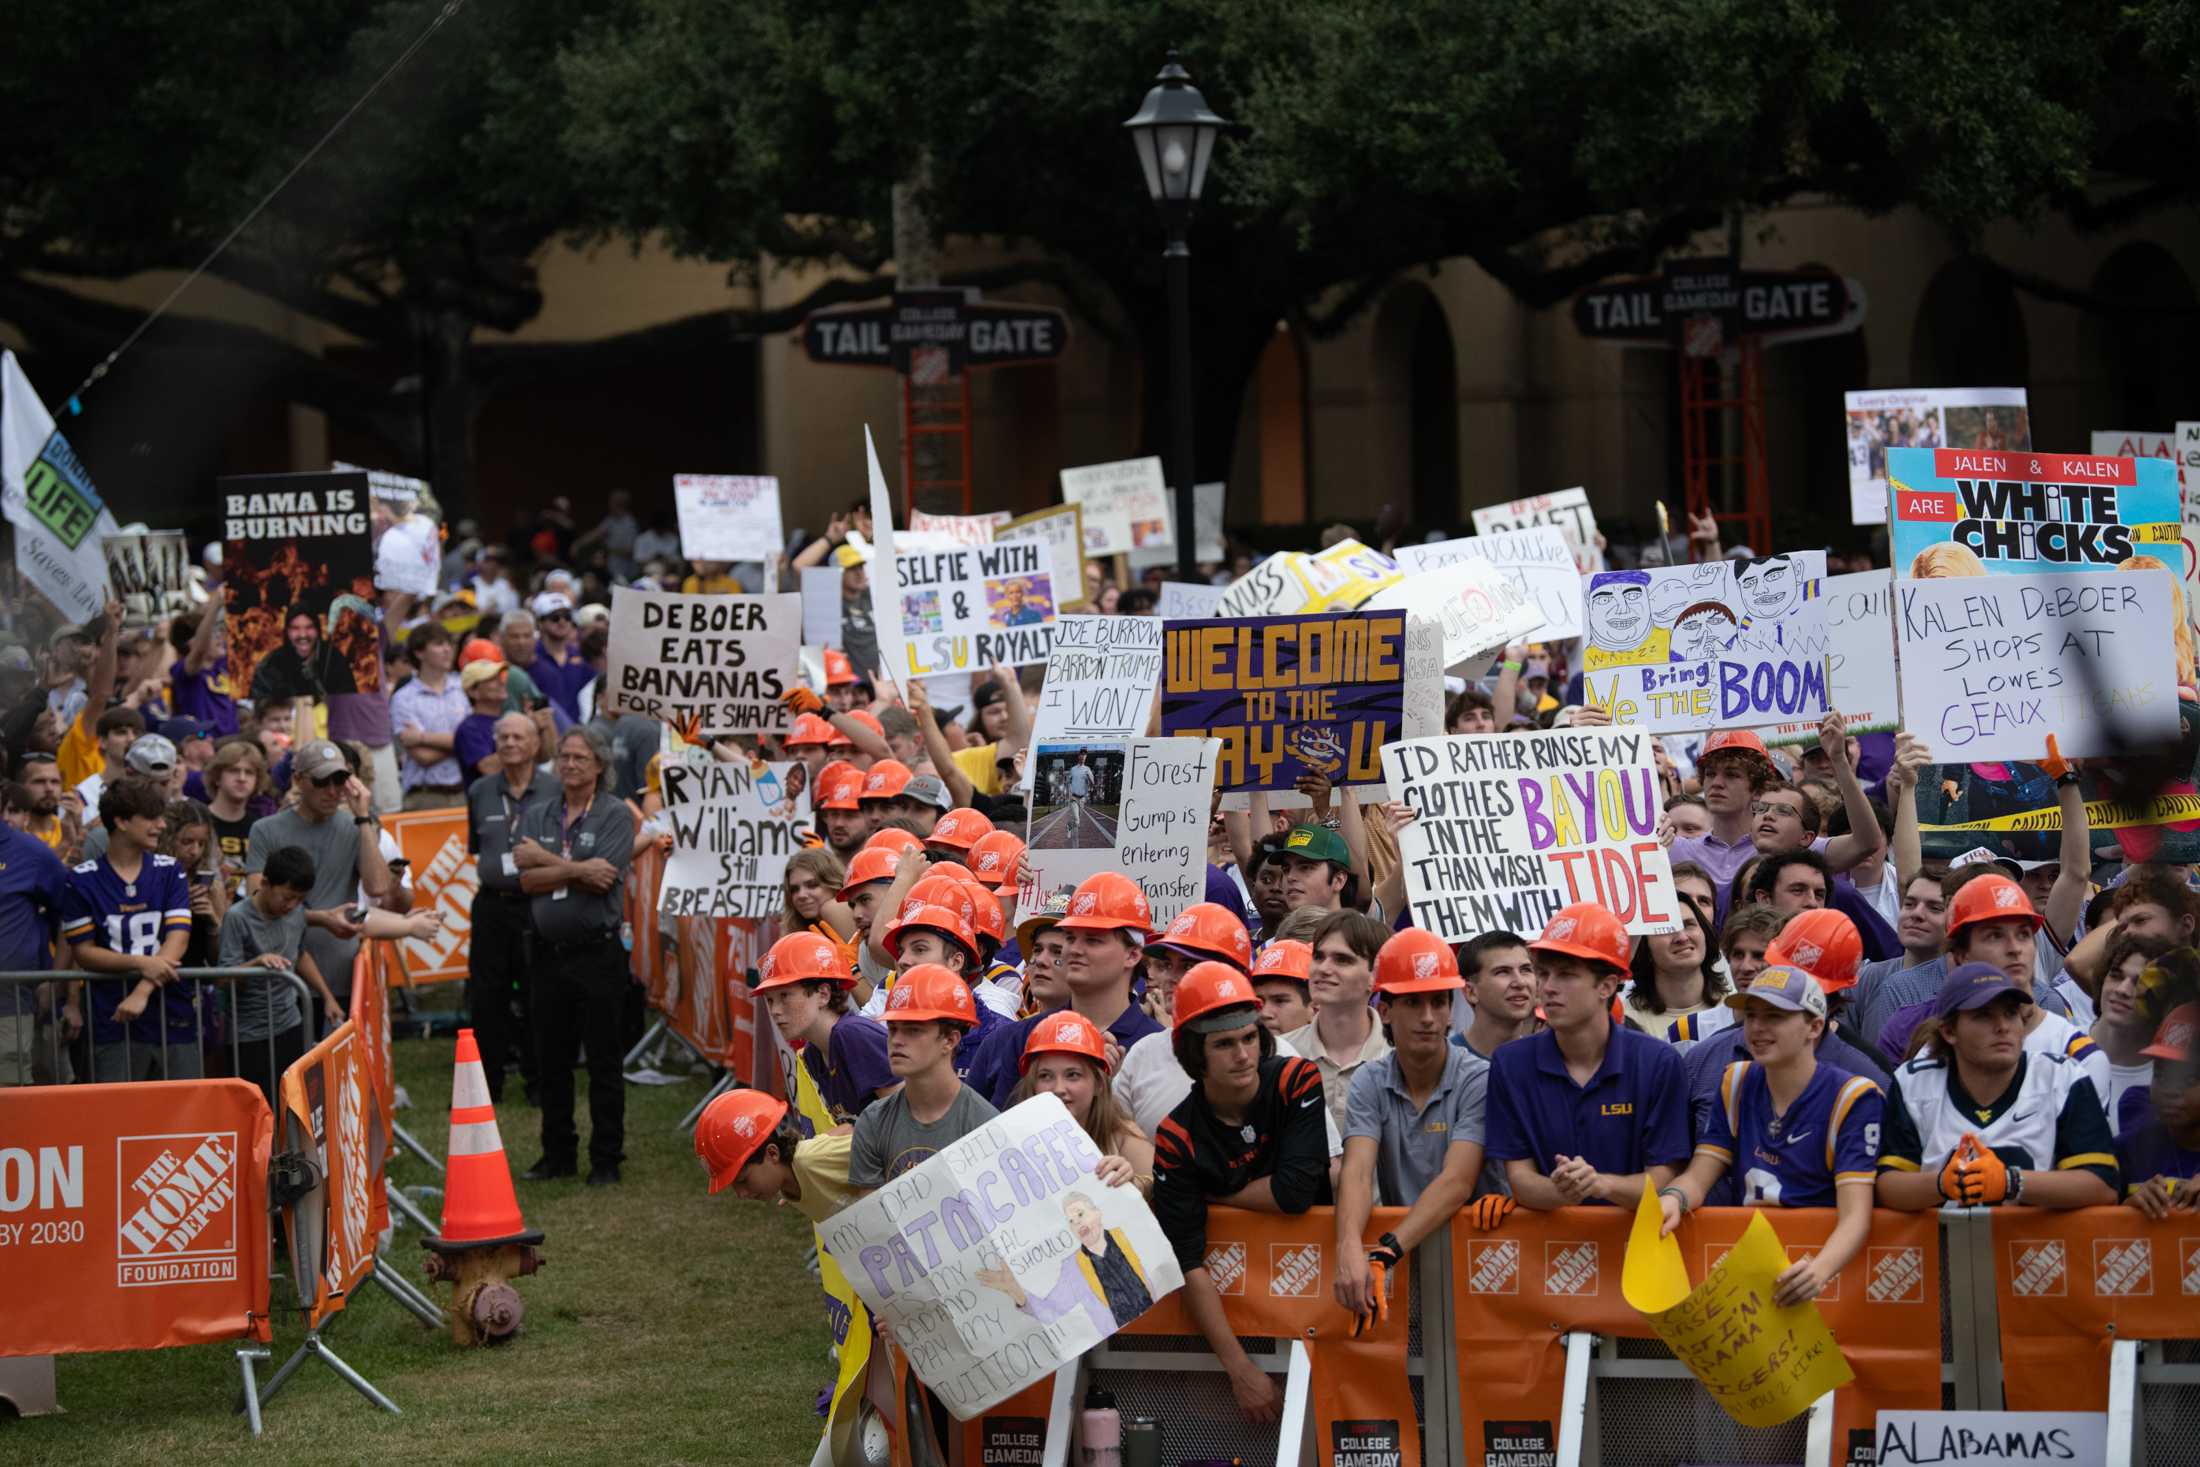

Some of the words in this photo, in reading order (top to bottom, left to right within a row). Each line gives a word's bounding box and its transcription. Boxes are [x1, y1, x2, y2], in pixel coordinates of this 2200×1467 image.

[1588, 293, 1661, 328] TAIL
[1745, 283, 1830, 319] GATE
[816, 322, 890, 354] TAIL
[969, 321, 1052, 352] GATE
[1953, 456, 2007, 473] JALEN
[2030, 459, 2042, 474] &
[2063, 460, 2120, 479] KALEN
[27, 470, 90, 540] LIFE
[226, 491, 318, 517] BAMA
[325, 489, 355, 512] IS
[1909, 498, 1945, 515] ARE
[225, 513, 367, 540] BURNING
[896, 552, 969, 588] SELFIE
[978, 544, 1039, 577] WITH
[952, 590, 970, 620] &
[1901, 586, 2004, 643] KALEN
[660, 636, 747, 668] EATS
[905, 635, 969, 676] LSU
[976, 626, 1056, 667] ROYALT
[1056, 620, 1089, 646] JOE
[1096, 618, 1162, 647] BURROW
[1166, 616, 1401, 693] WELCOME
[1943, 632, 2043, 672] SHOPS
[2058, 630, 2115, 657] AT
[621, 663, 784, 701] BANANAS
[1110, 653, 1160, 684] TRUMP
[1646, 687, 1712, 720] THE
[1718, 653, 1834, 722] BOOM!
[1962, 667, 2064, 697] LOWE'S
[617, 691, 664, 718] FOR
[722, 703, 790, 730] SHAPE
[1045, 688, 1064, 708] I
[1071, 685, 1152, 728] WON'T
[1243, 691, 1276, 721] TO
[1286, 690, 1338, 720] THE
[1583, 673, 1639, 727] We
[1641, 660, 1711, 694] Bring
[1841, 712, 1873, 724] EPOT
[1940, 699, 2046, 746] GEAUX
[1129, 744, 1208, 791] Forest
[1174, 724, 1285, 786] AY
[1393, 744, 1439, 784] I'D
[1447, 739, 1531, 776] RATHER
[1530, 736, 1599, 769] RINSE
[1598, 733, 1641, 766] MY
[662, 764, 752, 807] RYAN
[670, 804, 810, 858] Williams
[1124, 798, 1177, 836] Gump
[1183, 806, 1197, 825] is
[1403, 779, 1515, 822] CLOTHES
[1517, 767, 1656, 851] BAYOU
[2010, 811, 2063, 831] CAUTIO
[416, 832, 467, 894] THE
[717, 853, 759, 886] Still
[1121, 842, 1190, 867] entering
[1136, 873, 1200, 899] Transfer
[1412, 855, 1478, 893] THAN
[1485, 853, 1549, 889] WASH
[1547, 841, 1670, 926] TIDE
[104, 913, 164, 956] 18
[1412, 889, 1500, 939] THEM
[1496, 887, 1563, 934] WITH
[1601, 1102, 1632, 1117] LSU
[1863, 1122, 1882, 1157] 9
[0, 1144, 84, 1213] ON
[120, 1135, 235, 1253] HOME
[131, 1149, 181, 1198] THE
[831, 1214, 867, 1255] MY
[879, 1170, 933, 1224] DAD
[947, 1122, 1010, 1173] SAID
[166, 1176, 234, 1253] DEPOT
[0, 1223, 25, 1257] BY
[31, 1220, 85, 1255] 2030
[1009, 1228, 1074, 1276] SHOULD
[123, 1262, 233, 1282] FOUNDATION
[927, 1260, 970, 1298] MY
[976, 1226, 1031, 1271] REAL
[1207, 1242, 1245, 1286] OME
[1270, 1244, 1320, 1296] HOME
[1471, 1240, 1519, 1292] HOME
[1546, 1242, 1598, 1294] HOME
[1867, 1247, 1922, 1301] HOME
[2012, 1240, 2065, 1296] HOME
[2095, 1239, 2151, 1296] HOME
[909, 1337, 955, 1377] PAY
[957, 1307, 1010, 1351] MY
[1714, 1328, 1798, 1396] IGERS!
[983, 1447, 1046, 1465] GAMEDAY
[991, 1433, 1040, 1448] COLLEGE
[1333, 1453, 1401, 1467] GAMEDAY
[1340, 1436, 1391, 1451] COLLEGE
[1485, 1453, 1555, 1467] GAMEDAY
[1492, 1437, 1546, 1451] COLLEGE
[1877, 1420, 2076, 1466] ALABAMAS
